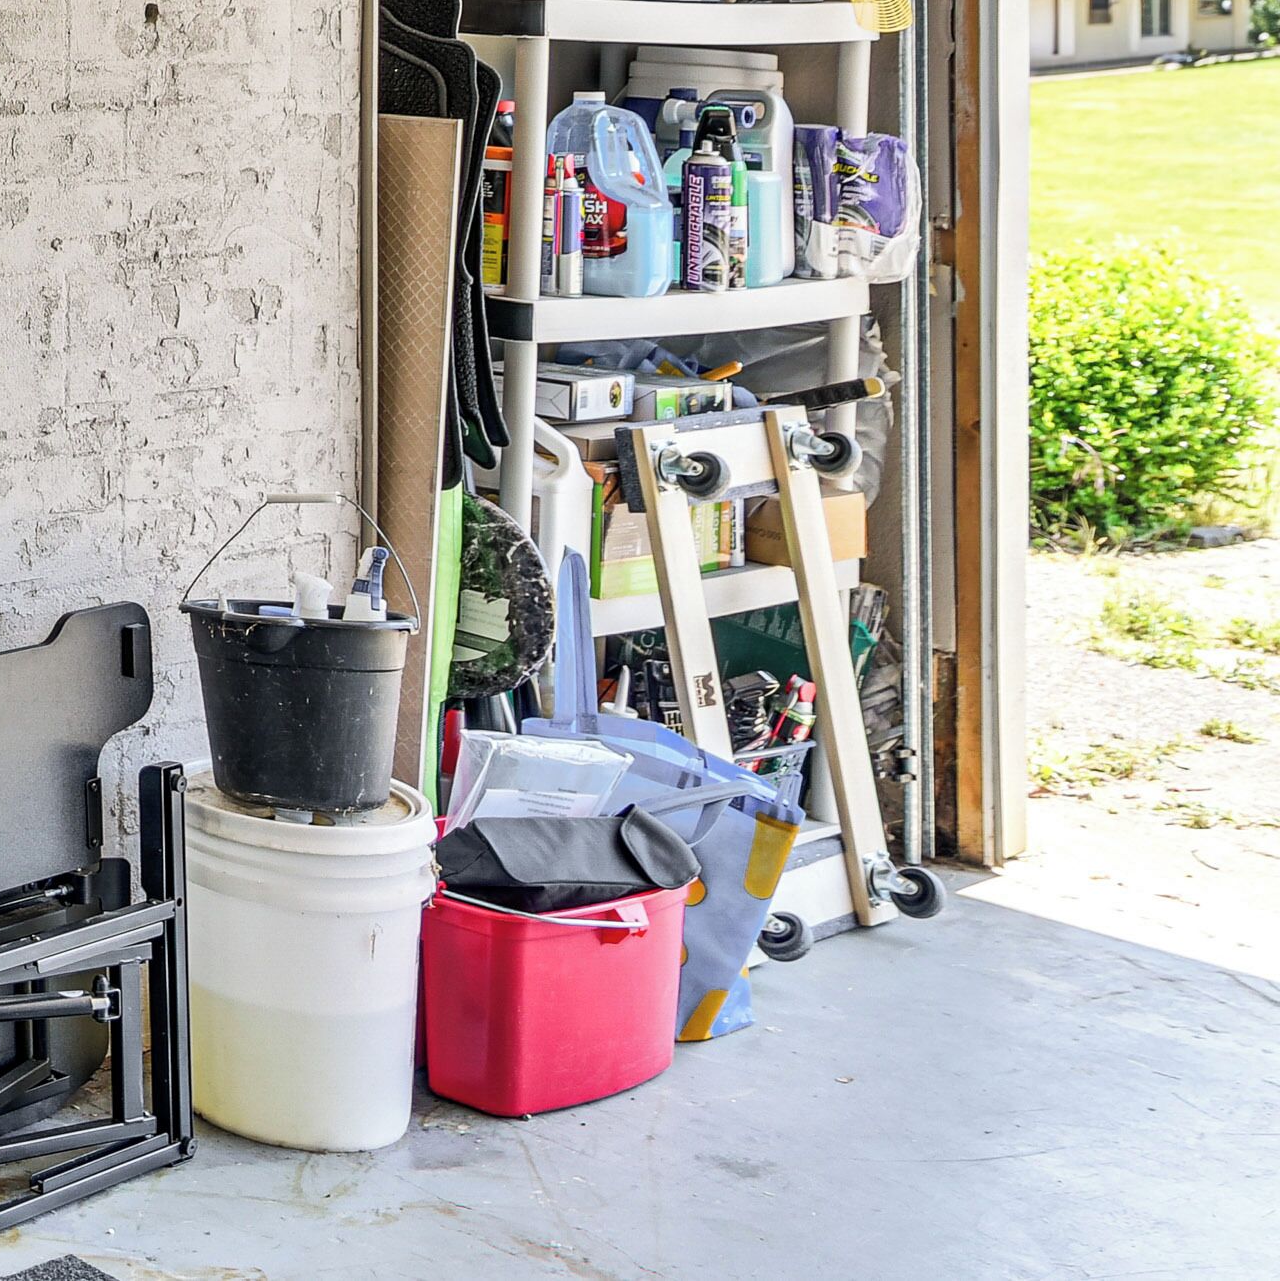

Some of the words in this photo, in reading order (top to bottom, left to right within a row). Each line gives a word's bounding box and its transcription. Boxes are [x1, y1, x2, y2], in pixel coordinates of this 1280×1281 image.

[585, 200, 608, 214] SH
[586, 214, 604, 225] AX
[687, 174, 704, 285] UNTOUCHABLE
